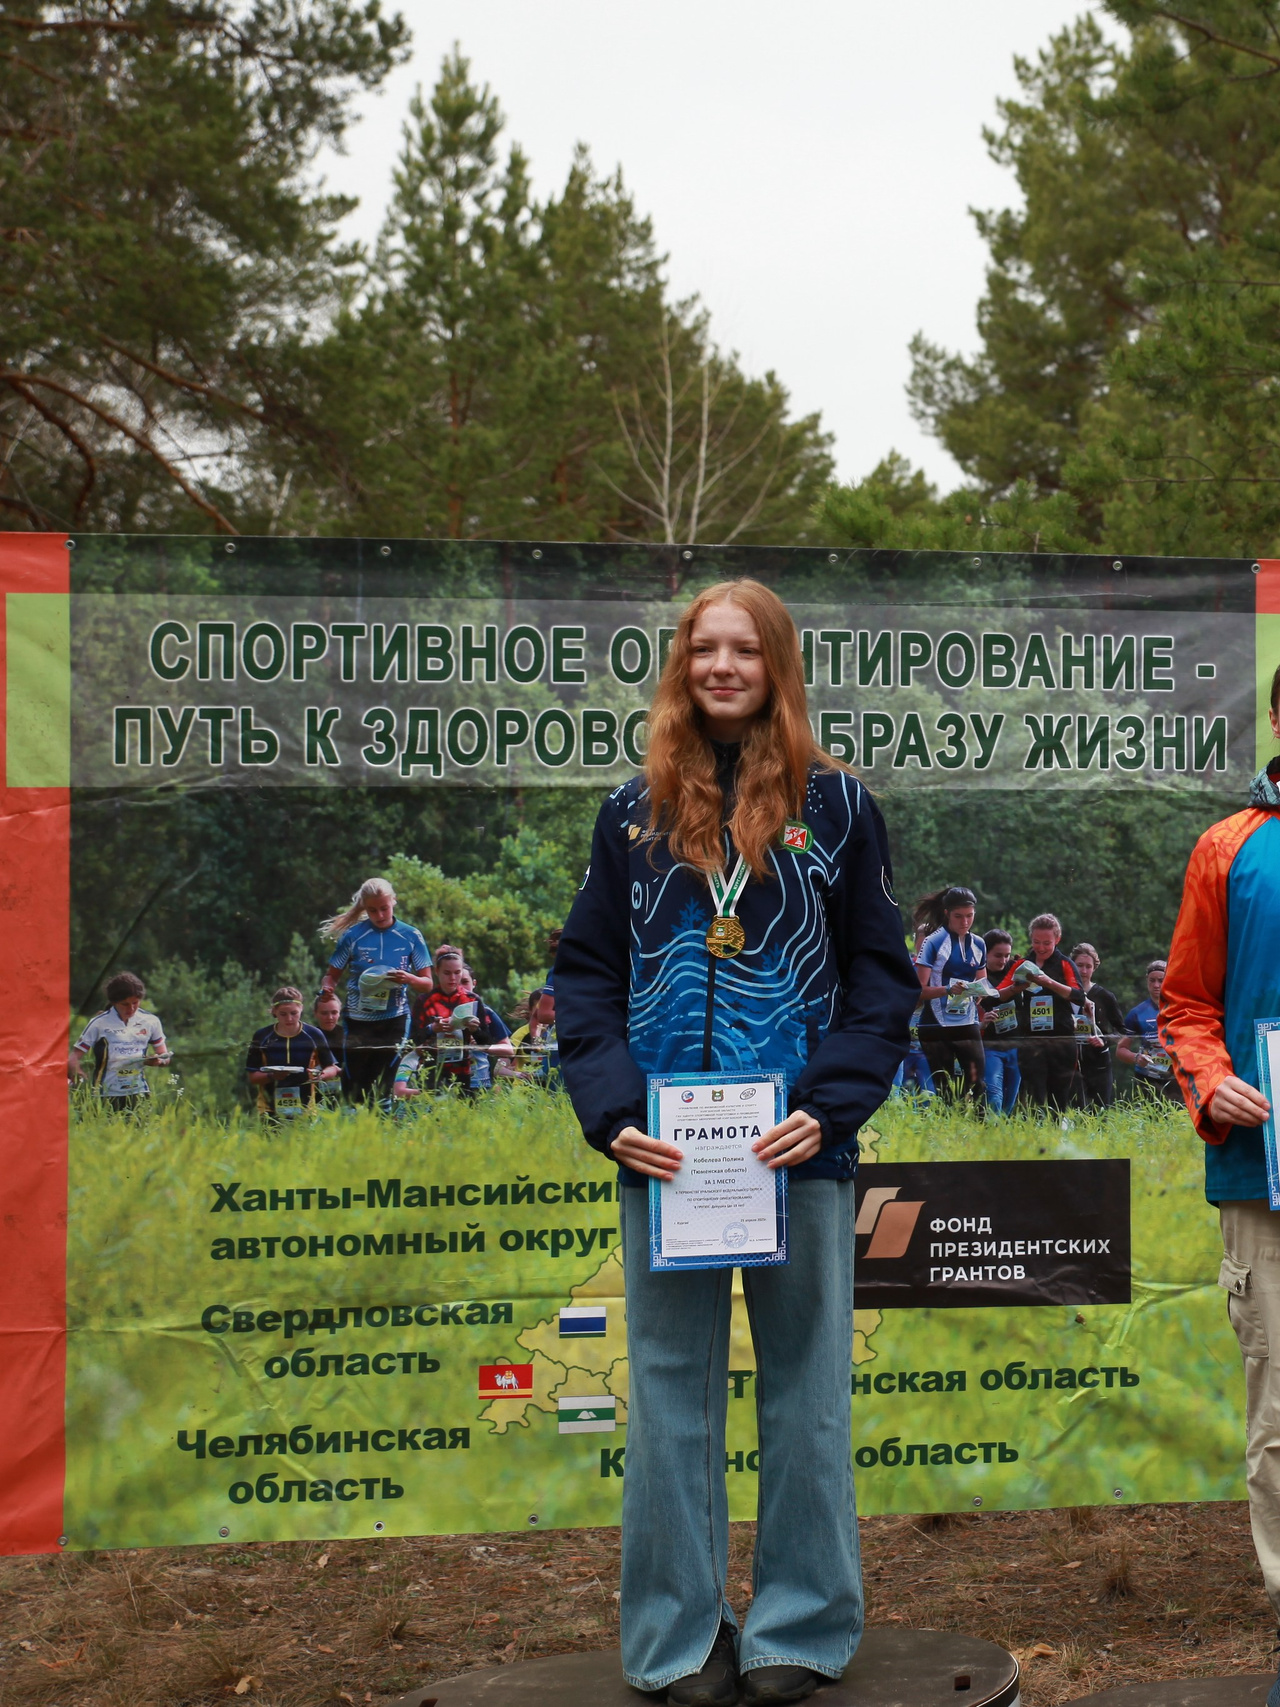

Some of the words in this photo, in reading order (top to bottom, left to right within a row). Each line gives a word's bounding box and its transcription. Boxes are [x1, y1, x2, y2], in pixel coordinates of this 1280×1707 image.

[150, 620, 587, 685] СПОРТИВНОЕ
[113, 705, 281, 768] ПУТЬ
[304, 706, 342, 768] К
[361, 706, 652, 779] ЗДОРОВО
[808, 711, 1006, 770] БРАЗУ
[1023, 713, 1228, 772] ЖИЗНИ
[733, 863, 747, 890] КУРГАНСКА
[998, 1009, 1013, 1019] 504
[1032, 1008, 1050, 1016] 4501
[673, 1125, 762, 1141] ГРАМОТА
[695, 1143, 742, 1152] награждается
[693, 1156, 721, 1164] Кобелева
[930, 1216, 992, 1234] ФОНД
[210, 1222, 486, 1260] автономный
[499, 1227, 618, 1258] округ
[930, 1239, 1111, 1258] ПРЕЗИДЕНТСКИХ
[930, 1265, 1026, 1282] ГРАНТОВ
[200, 1300, 514, 1339] Свердловская
[263, 1347, 441, 1380] область
[979, 1360, 1141, 1392] область
[175, 1425, 471, 1460] Челябинская
[854, 1436, 1020, 1468] область
[227, 1471, 406, 1505] область
